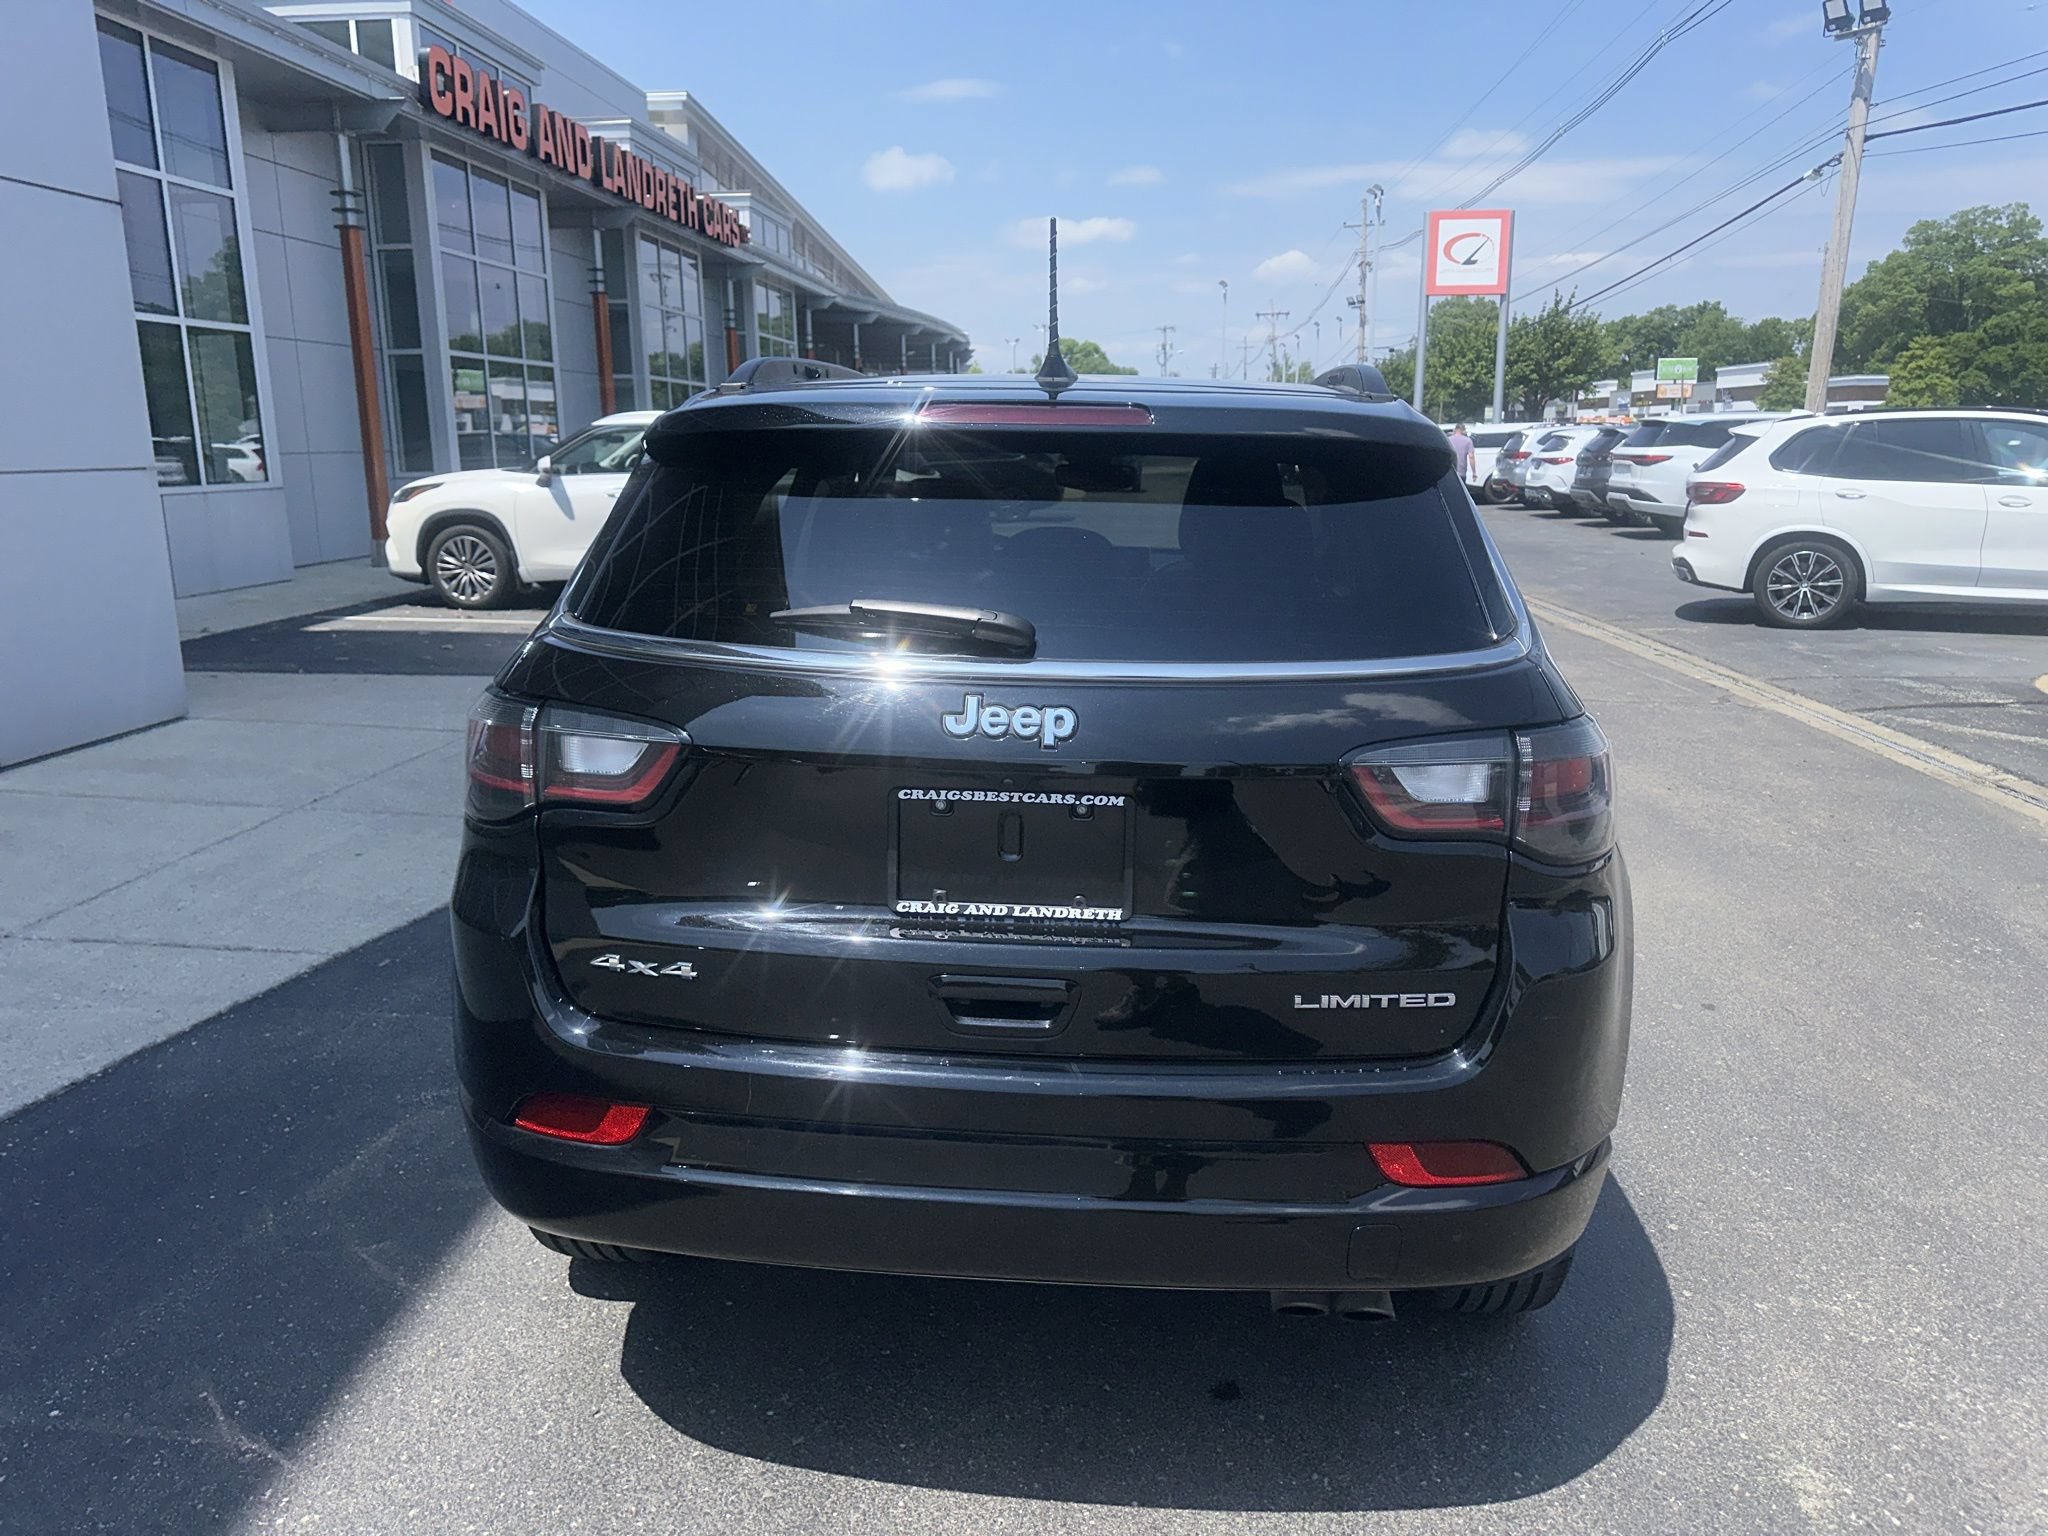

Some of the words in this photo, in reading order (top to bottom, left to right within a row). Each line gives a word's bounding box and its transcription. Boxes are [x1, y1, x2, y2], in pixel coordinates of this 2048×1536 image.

[427, 44, 529, 151] CRAIG
[538, 103, 593, 181] AND
[600, 136, 700, 231] LANDRETH
[703, 193, 741, 249] CARS
[943, 693, 1078, 751] Jeep
[898, 789, 1125, 806] CRAIGSBESTCARS.COM
[896, 901, 960, 915] CRAIG
[963, 904, 1009, 917] AND
[1012, 905, 1122, 921] LANDRETH
[590, 953, 698, 980] 4x4
[1294, 992, 1456, 1009] LIMITED
